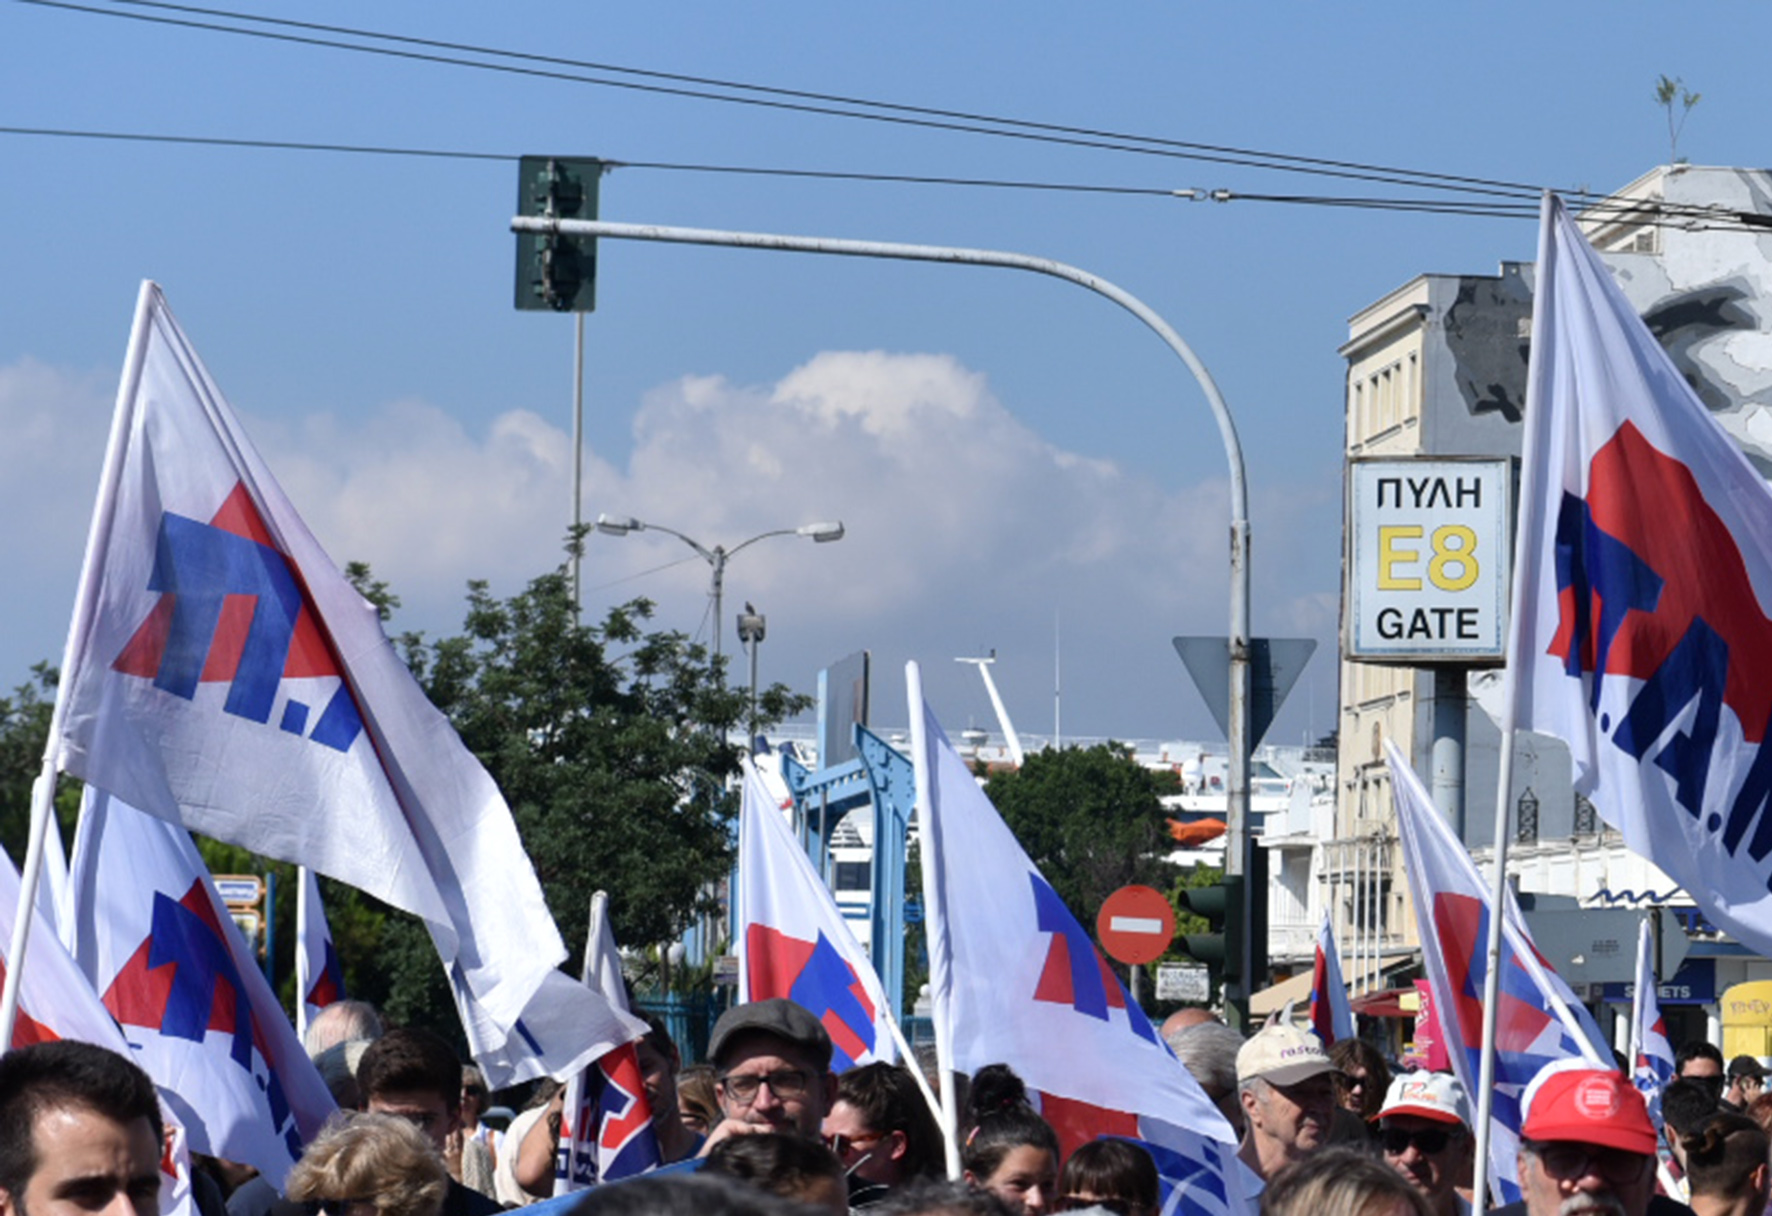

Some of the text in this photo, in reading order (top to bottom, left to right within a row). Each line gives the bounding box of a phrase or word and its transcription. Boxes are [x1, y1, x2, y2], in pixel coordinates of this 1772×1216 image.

[1377, 477, 1481, 509] ΠΥΛΗ
[1377, 524, 1480, 592] E8
[1376, 607, 1479, 640] GATE
